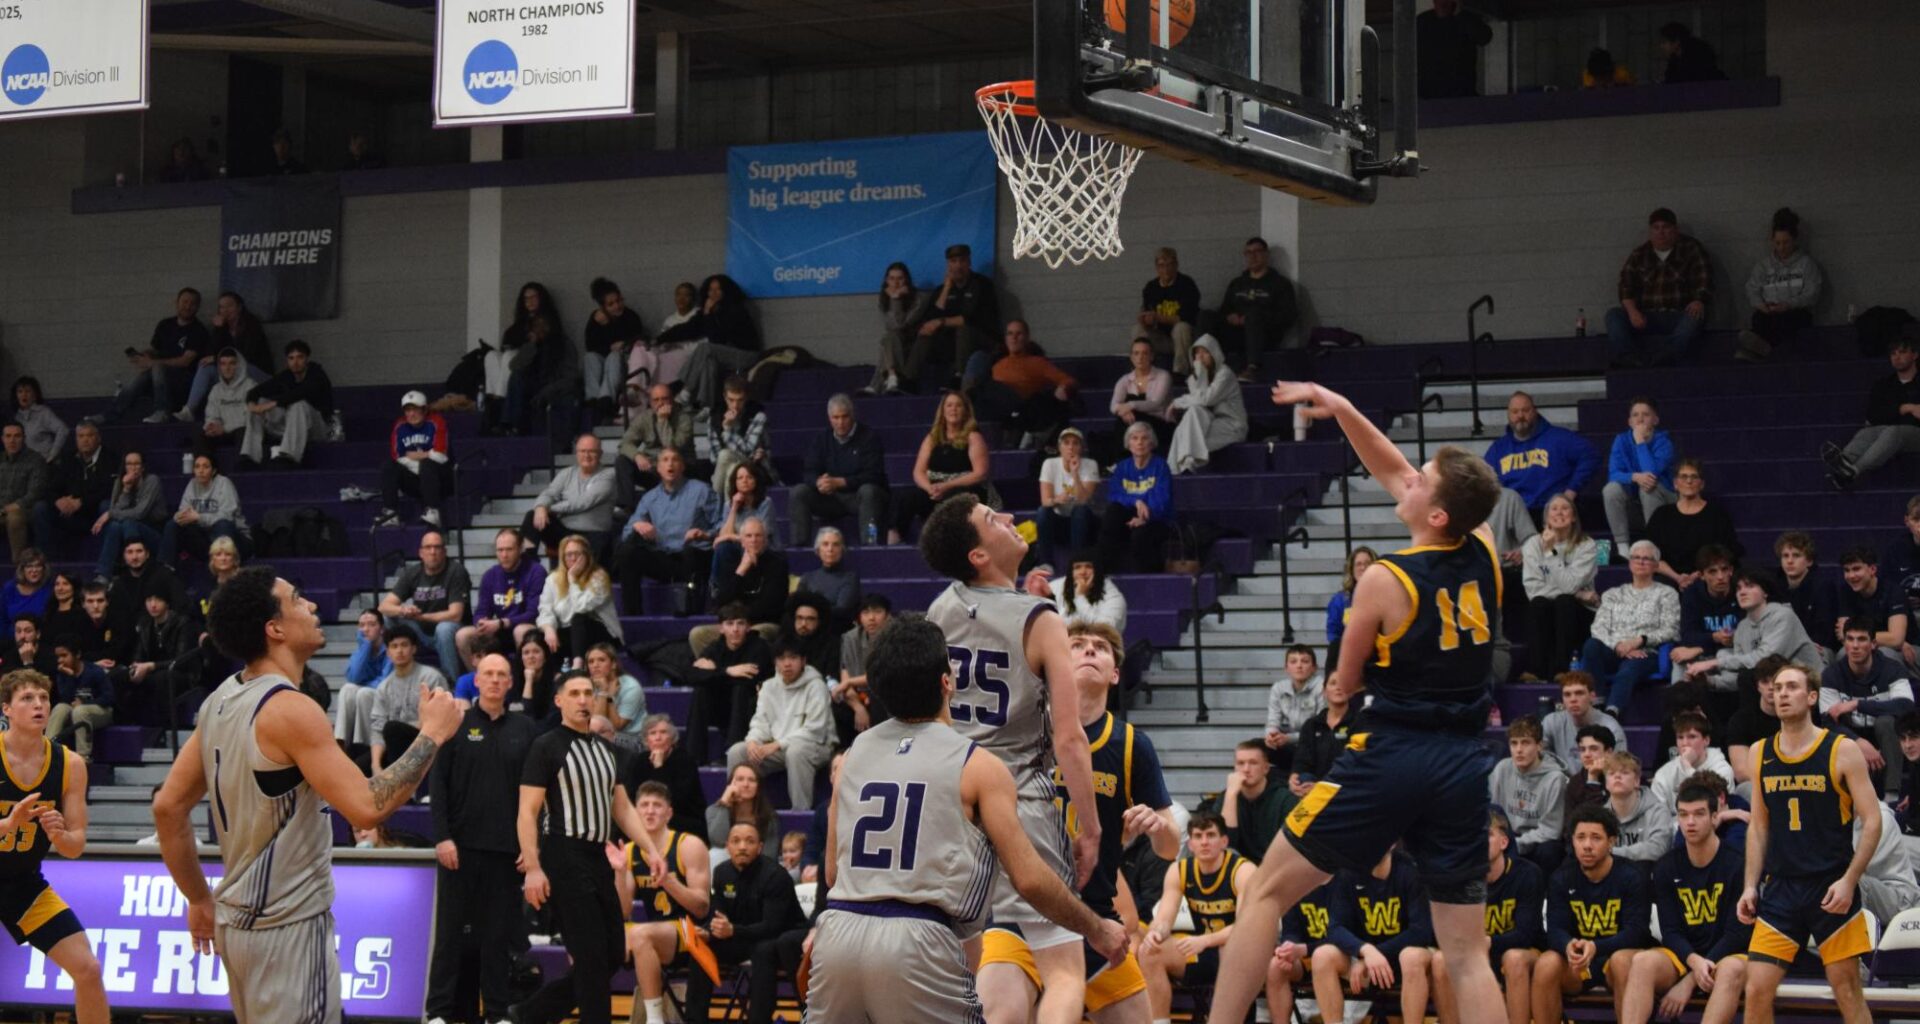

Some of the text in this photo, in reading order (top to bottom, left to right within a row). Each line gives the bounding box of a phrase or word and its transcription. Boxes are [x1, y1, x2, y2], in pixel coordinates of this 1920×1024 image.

[467, 2, 604, 24] NORTH CHAMPIONS
[522, 24, 548, 37] 1982
[6, 66, 119, 91] NCAA Division III
[468, 65, 598, 90] NCAA Division III
[748, 157, 857, 182] Supporting
[749, 182, 927, 211] big league dreams.
[228, 229, 332, 251] CHAMPIONS
[236, 247, 320, 268] WIN HERE
[773, 265, 842, 283] Geisinger
[1500, 448, 1549, 475] WILKES
[1436, 580, 1492, 651] 14
[946, 646, 1010, 728] 25
[215, 748, 228, 832] 1
[1763, 775, 1826, 794] WILKES
[850, 781, 927, 871] 21
[1788, 797, 1801, 831] 1
[654, 890, 672, 916] 4
[1678, 882, 1724, 926] W
[1358, 897, 1401, 936] W
[1569, 898, 1622, 938] W
